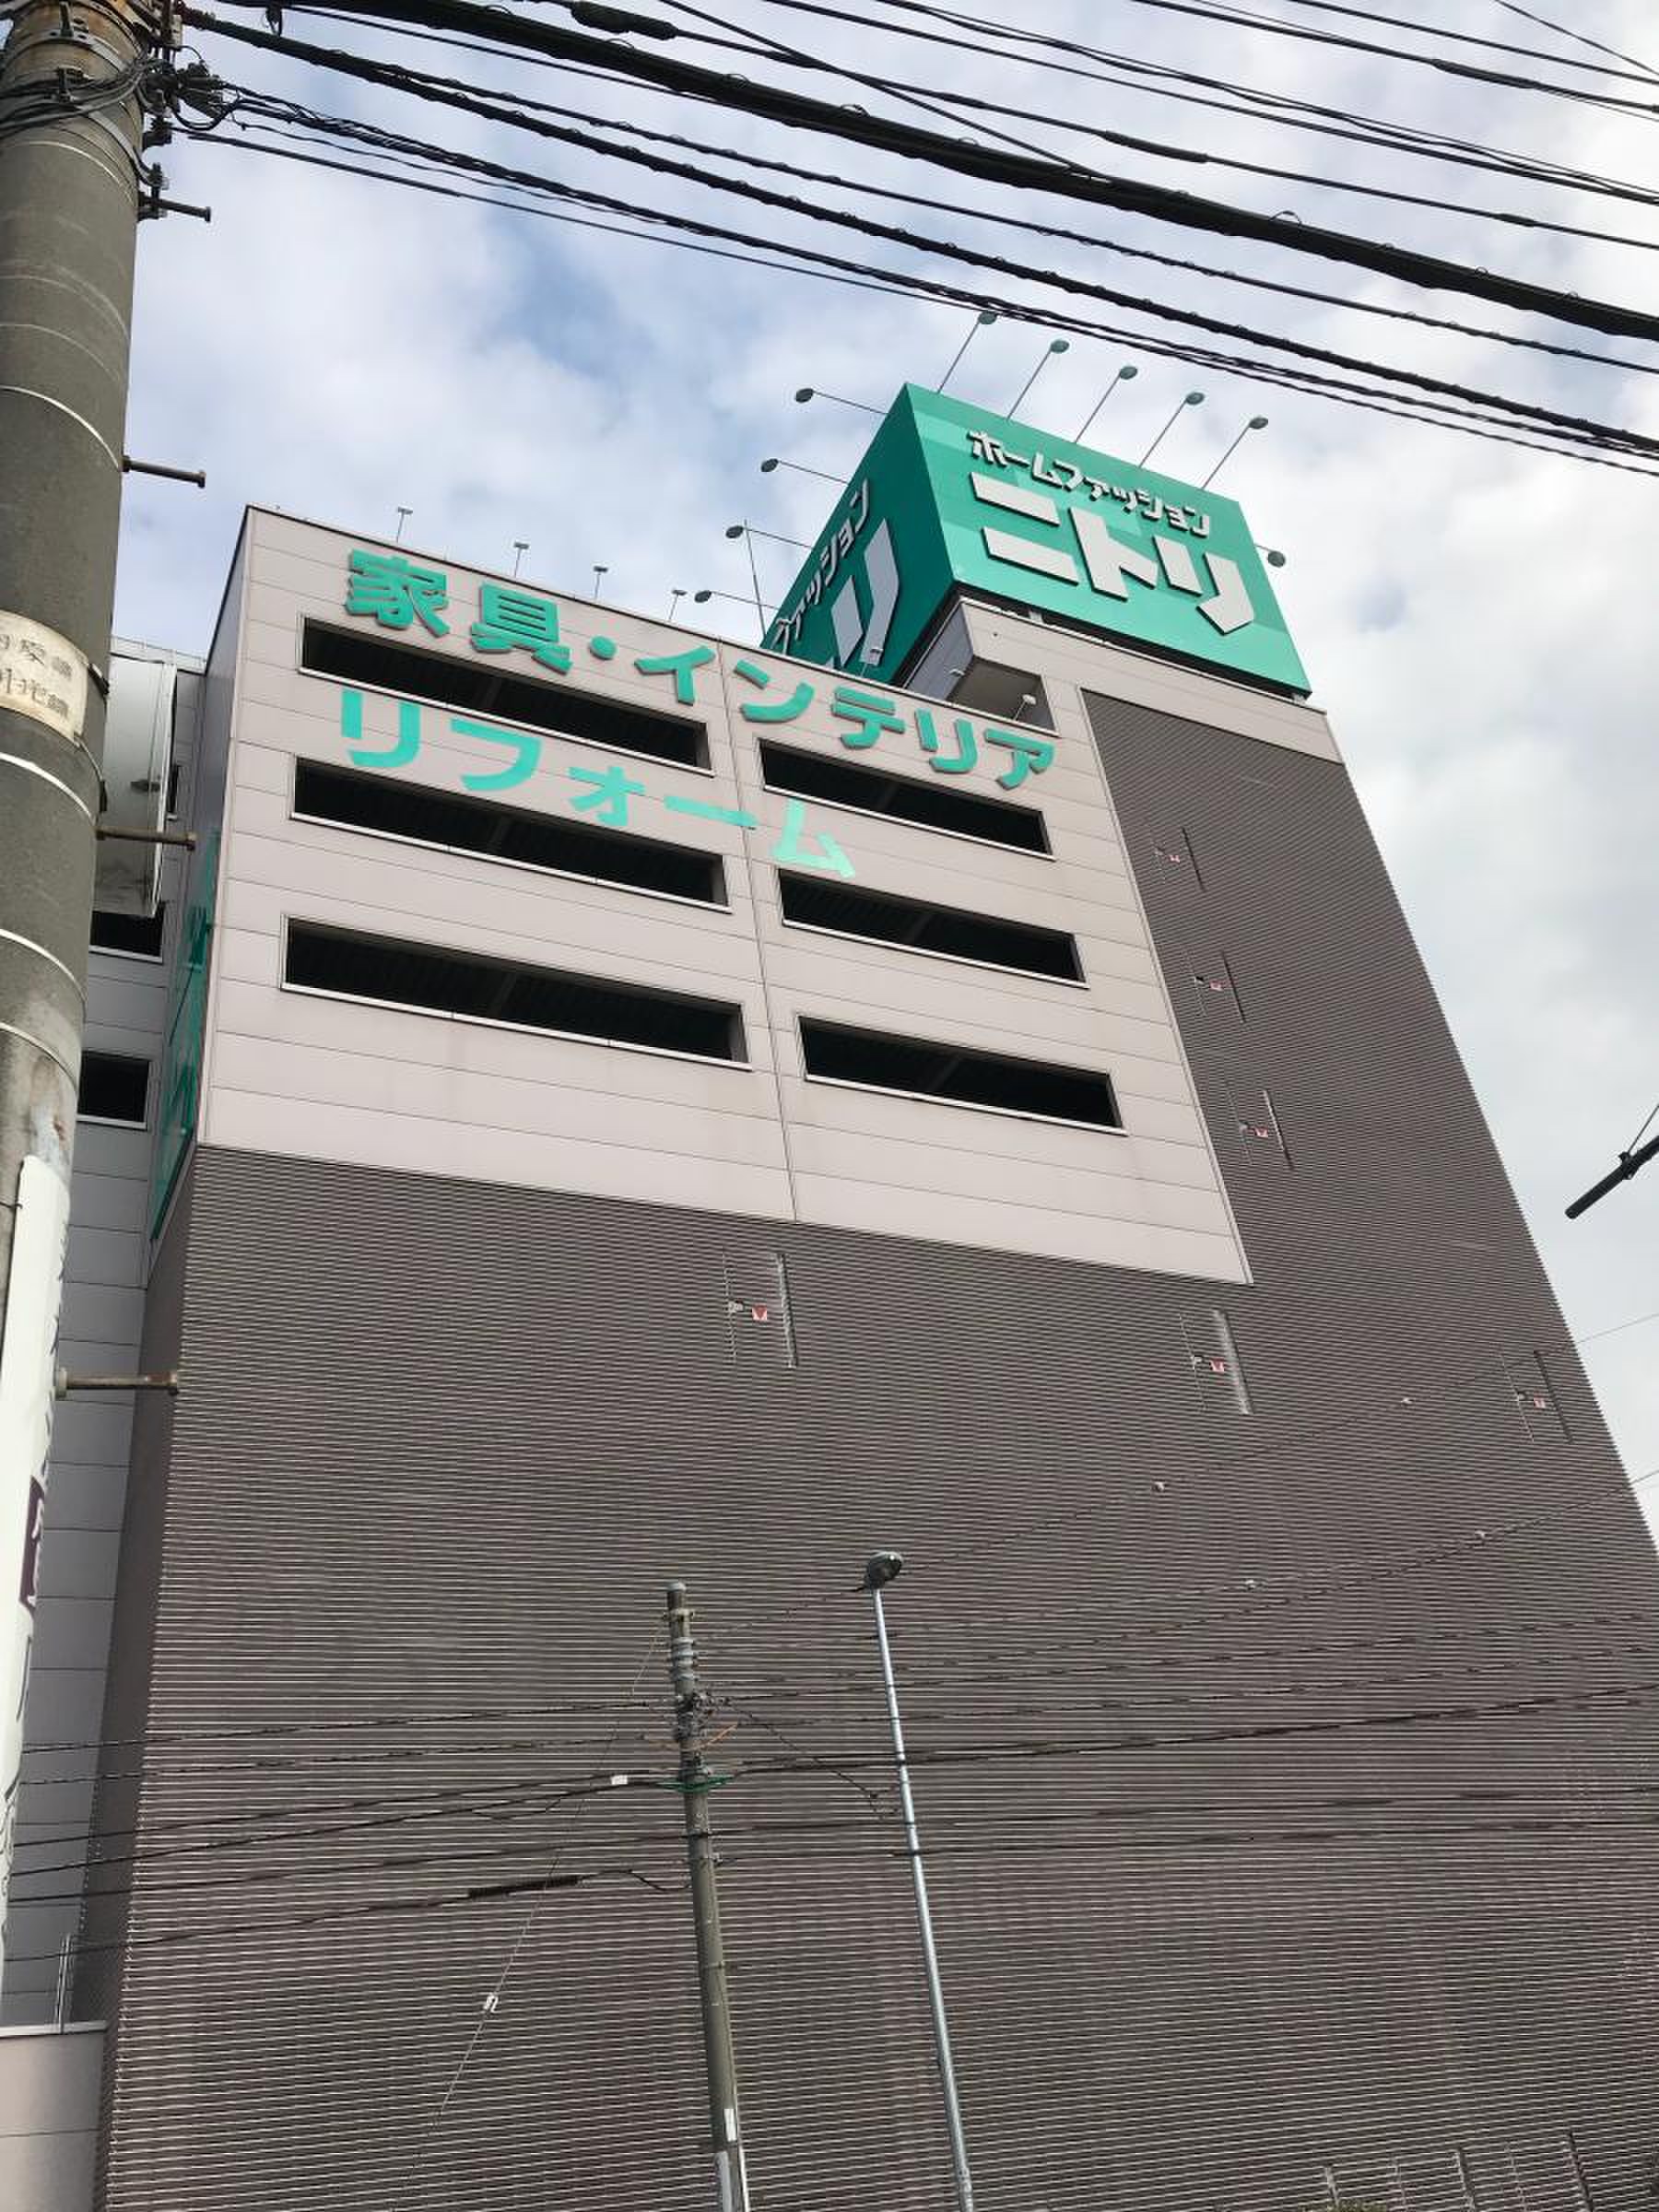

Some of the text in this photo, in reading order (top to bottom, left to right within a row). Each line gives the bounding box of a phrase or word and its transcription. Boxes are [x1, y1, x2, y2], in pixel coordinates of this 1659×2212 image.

[967, 430, 1211, 536] ホームファッション
[971, 471, 1255, 634] ニトリ
[346, 549, 1055, 790] 家具・インテリア
[341, 687, 856, 877] リフォーム
